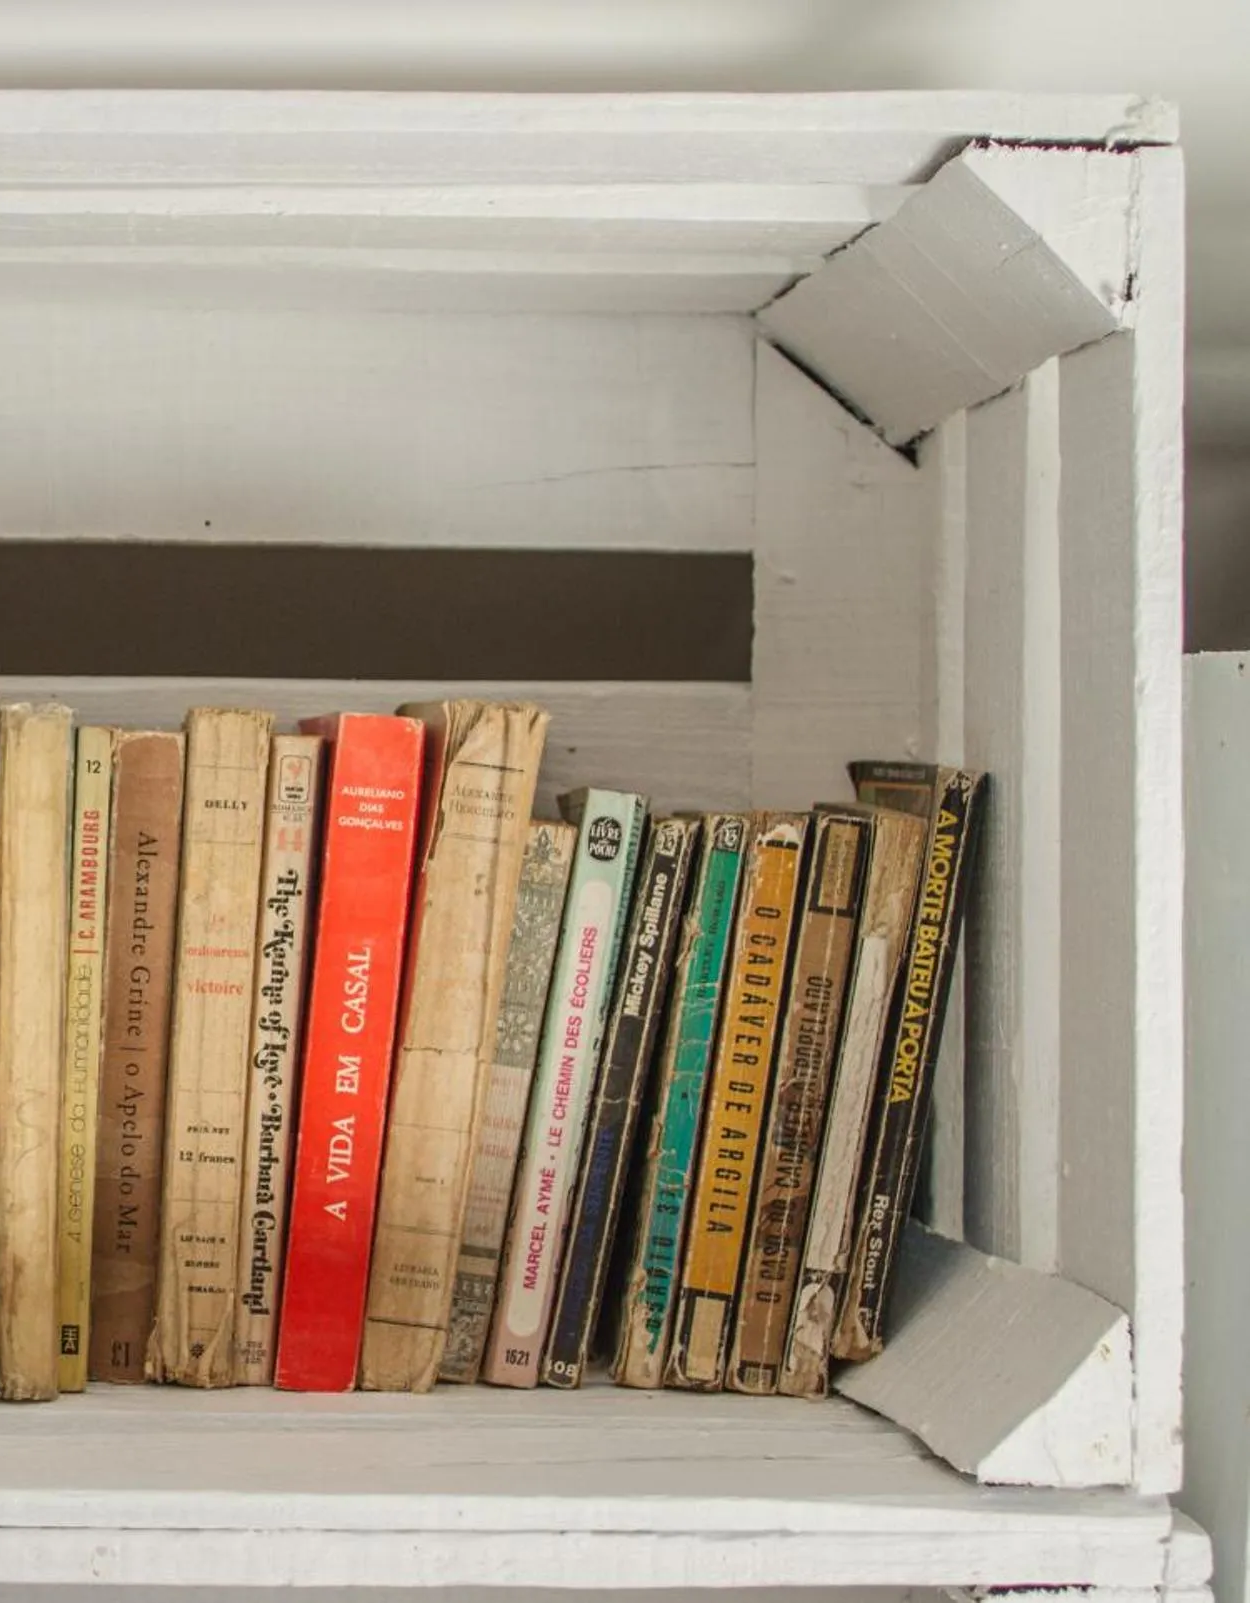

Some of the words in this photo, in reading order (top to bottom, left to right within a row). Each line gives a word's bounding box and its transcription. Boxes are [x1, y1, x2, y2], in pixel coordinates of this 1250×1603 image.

[86, 759, 102, 775] 12
[204, 799, 250, 812] DELLY
[341, 785, 406, 802] AURELIANO
[358, 802, 385, 815] DIAS
[936, 808, 959, 828] A
[337, 814, 404, 832] GONÇALVES
[78, 809, 100, 921] ARAMBOURG
[924, 833, 956, 921] MORTE
[130, 829, 159, 957] Alexandre
[266, 869, 302, 919] The
[637, 871, 670, 948] Spillane
[754, 906, 782, 921] O
[79, 926, 95, 940] C.
[569, 926, 599, 1010] ÉCOLIERS
[622, 949, 656, 1018] Mickey
[913, 924, 941, 998] BATEU
[125, 964, 152, 1037] Grine
[341, 945, 371, 1035] CASAL
[730, 934, 776, 1067] CADÁVER
[257, 1009, 291, 1042] of
[563, 1015, 583, 1050] DES
[335, 1054, 361, 1095] EM
[888, 1022, 925, 1104] PORTA
[551, 1055, 576, 1122] CHEMIN
[724, 1079, 755, 1115] DE
[64, 1103, 86, 1134] da
[118, 1084, 144, 1157] Apelo
[546, 1125, 564, 1148] LE
[178, 1150, 193, 1163] 12
[197, 1151, 236, 1165] francs
[255, 1101, 285, 1206] Barbara
[326, 1113, 356, 1184] VIDA
[117, 1164, 141, 1196] do
[534, 1167, 557, 1216] AYMÉ
[705, 1127, 747, 1235] ARGILA
[114, 1202, 138, 1255] Mar
[323, 1199, 348, 1222] A
[869, 1193, 892, 1231] Rex
[241, 1209, 278, 1317] Cartland
[521, 1221, 548, 1291] MARCEL
[862, 1237, 884, 1292] Stout
[753, 1291, 782, 1305] O
[505, 1347, 531, 1368] 1621
